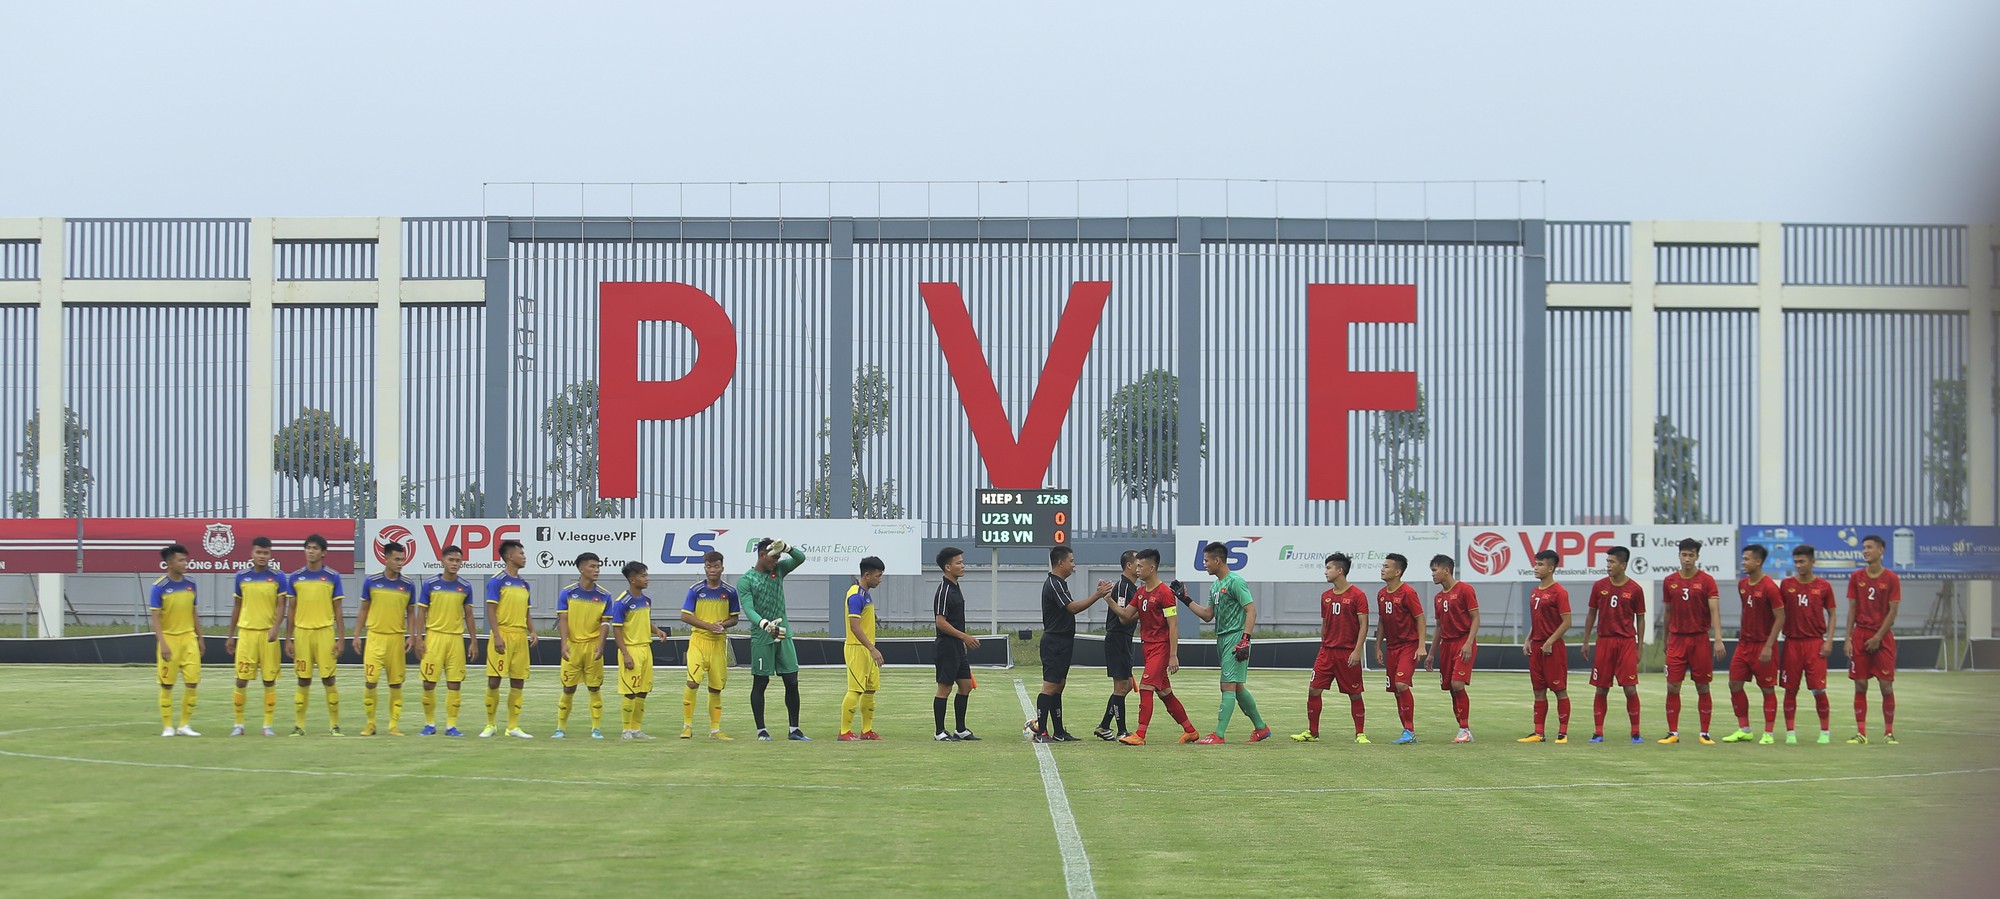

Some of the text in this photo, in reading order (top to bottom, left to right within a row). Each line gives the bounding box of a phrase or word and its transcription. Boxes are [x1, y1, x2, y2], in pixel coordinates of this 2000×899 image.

[982, 494, 1023, 504] HIEP 1
[1036, 495, 1068, 504] 17:58
[982, 513, 1033, 525] U23 VN
[1055, 512, 1065, 525] 0
[558, 531, 637, 543] V.league.VPF
[982, 530, 1033, 542] U18 VN
[1054, 530, 1065, 543] 0
[423, 525, 520, 561] VPF
[661, 533, 716, 564] LS
[1518, 531, 1615, 567] VPF
[1194, 540, 1249, 571] LS
[214, 559, 230, 569] ĐÁ
[1682, 588, 1689, 601] 3
[1797, 594, 1808, 606] 14
[1868, 587, 1875, 600] 2
[1142, 599, 1148, 612] 8
[1443, 600, 1449, 613] 9
[1534, 597, 1540, 610] 7
[1610, 595, 1618, 608] 6
[1747, 594, 1753, 608] 4
[1331, 602, 1341, 615] 10
[1384, 601, 1393, 615] 19
[238, 662, 250, 673] 23
[425, 662, 434, 676] 15
[497, 659, 504, 672] 8
[692, 663, 700, 676] 7
[758, 657, 763, 671] 1
[162, 666, 169, 679] 2
[563, 670, 569, 682] 5
[1592, 668, 1598, 680] 6
